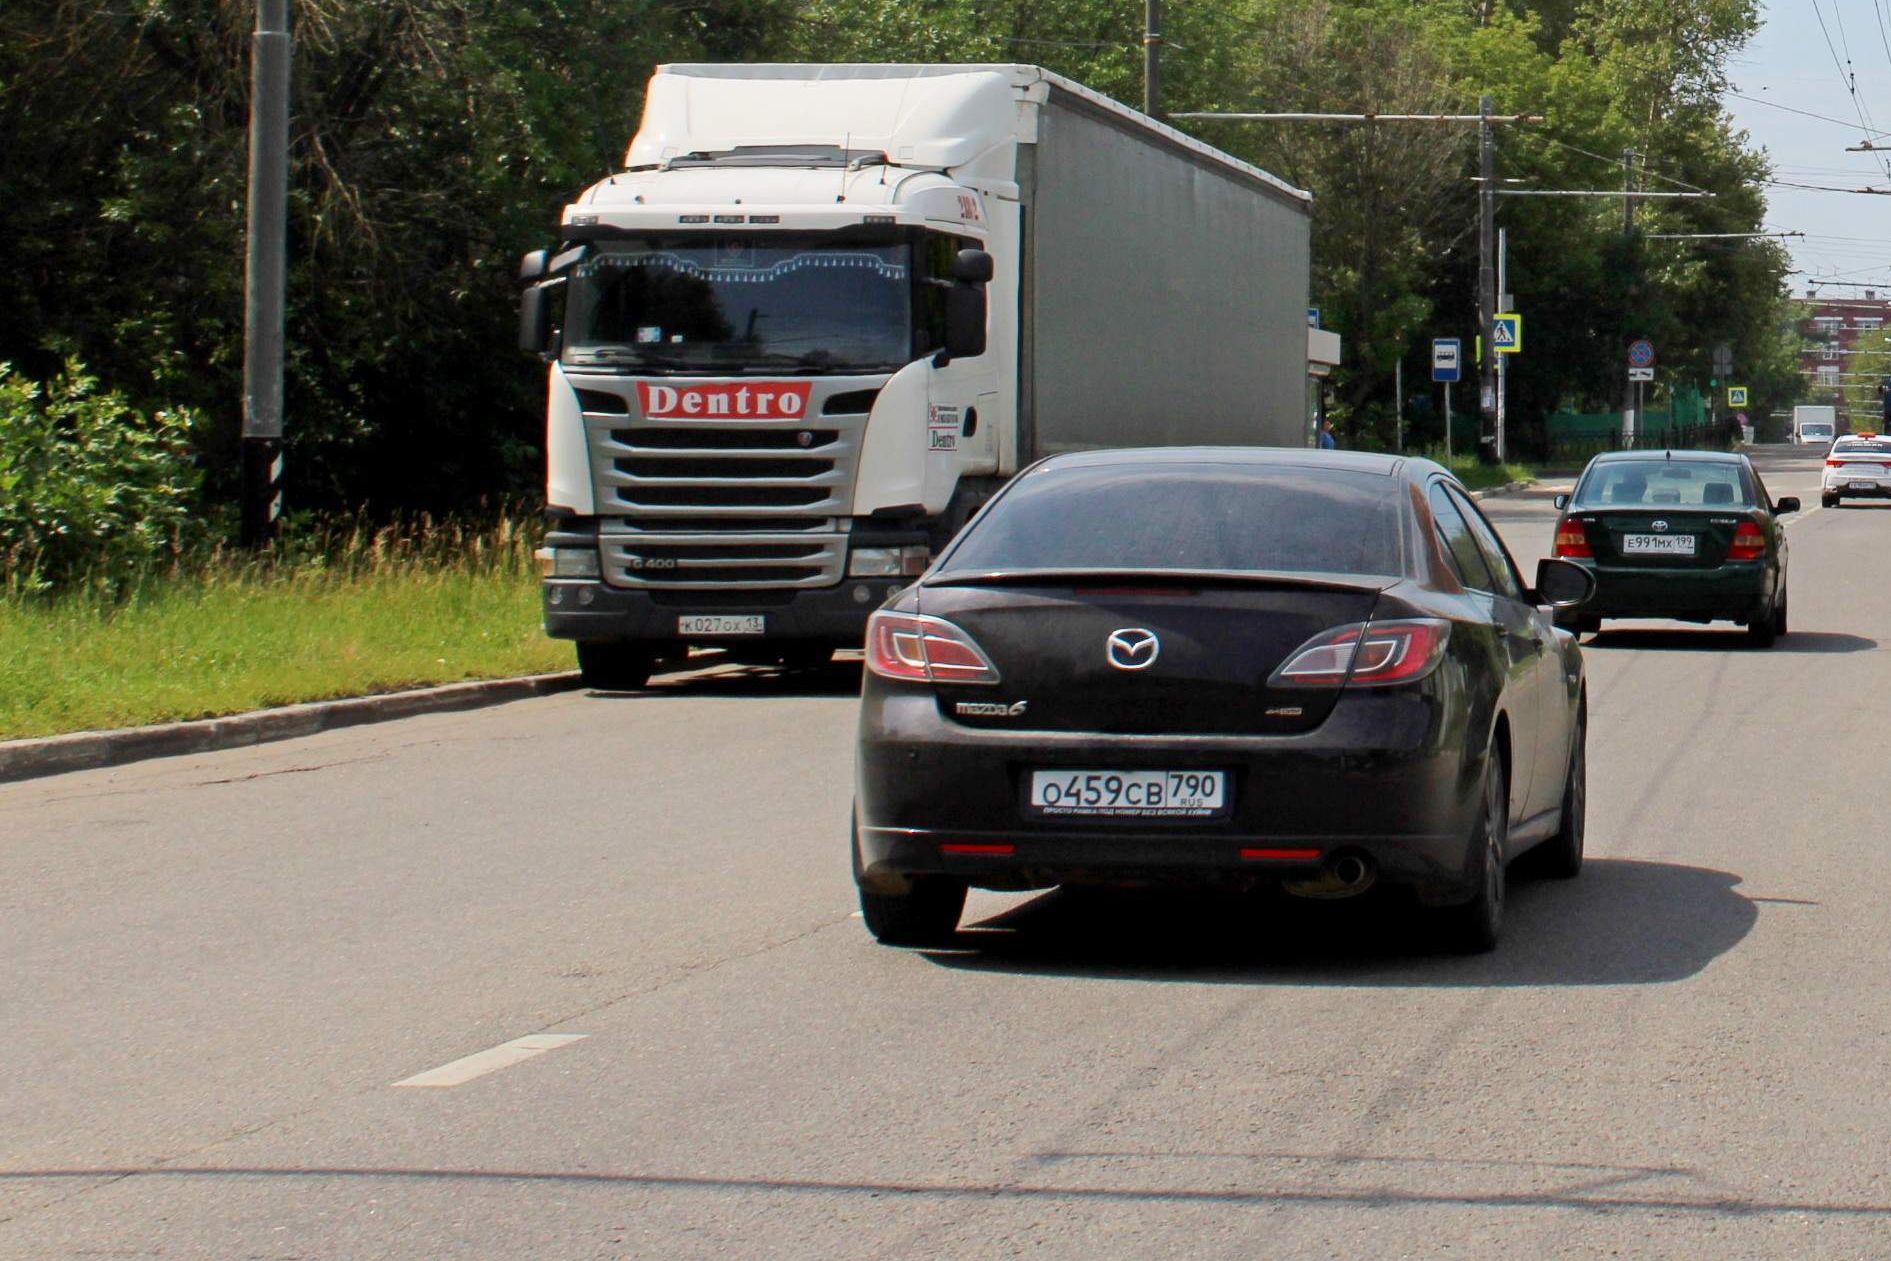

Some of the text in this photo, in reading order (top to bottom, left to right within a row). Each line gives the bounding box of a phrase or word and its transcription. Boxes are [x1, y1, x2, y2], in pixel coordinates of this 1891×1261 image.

[647, 385, 802, 415] Dentro
[1628, 536, 1692, 549] Е991МХ 199
[645, 558, 676, 569] 400
[683, 618, 742, 632] К027ОХ
[1042, 774, 1216, 806] О459СВ 790
[1180, 798, 1204, 807] RUS
